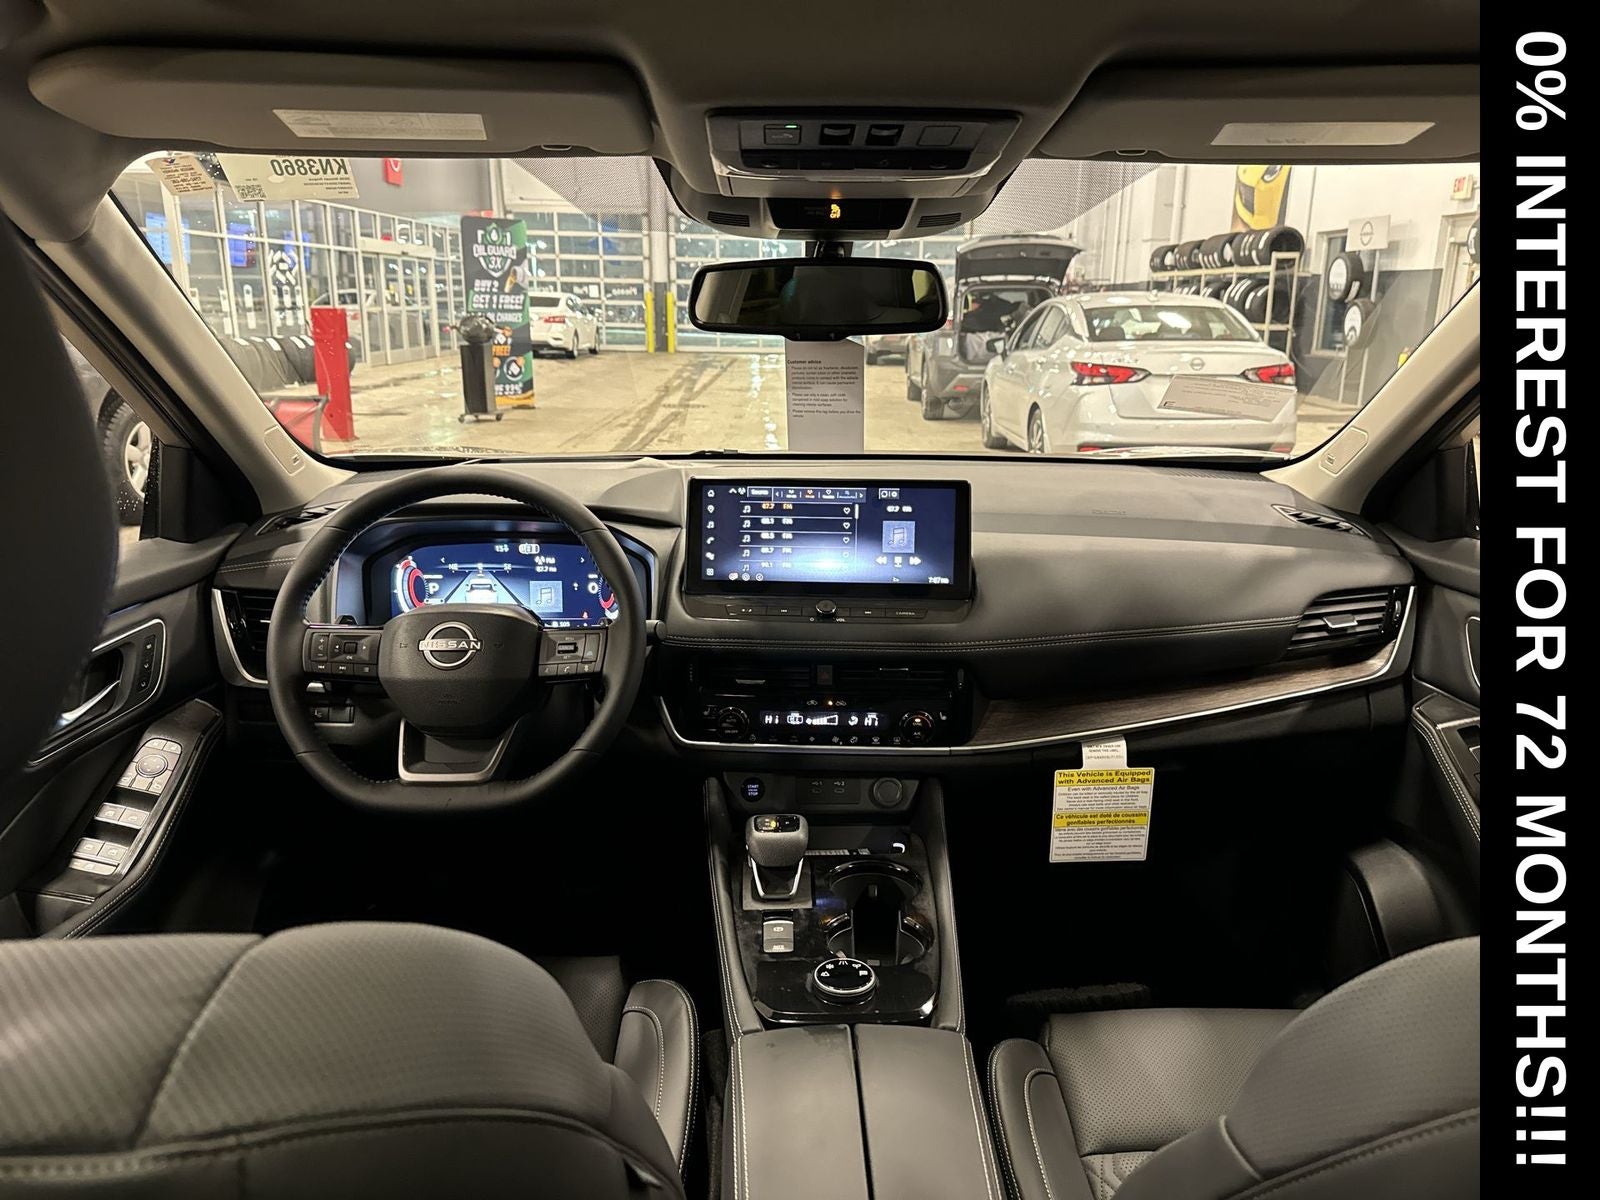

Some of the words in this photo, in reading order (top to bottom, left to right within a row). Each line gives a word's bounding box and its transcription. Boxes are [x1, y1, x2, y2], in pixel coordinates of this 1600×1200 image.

[473, 244, 487, 258] OIL
[487, 244, 517, 259] GUARD
[489, 256, 501, 269] 3X
[474, 279, 491, 292] BUY
[492, 280, 499, 292] 2
[472, 294, 490, 308] GET
[492, 294, 498, 308] 1
[429, 582, 439, 594] P
[588, 582, 598, 594] 0
[420, 640, 480, 649] NISSAN
